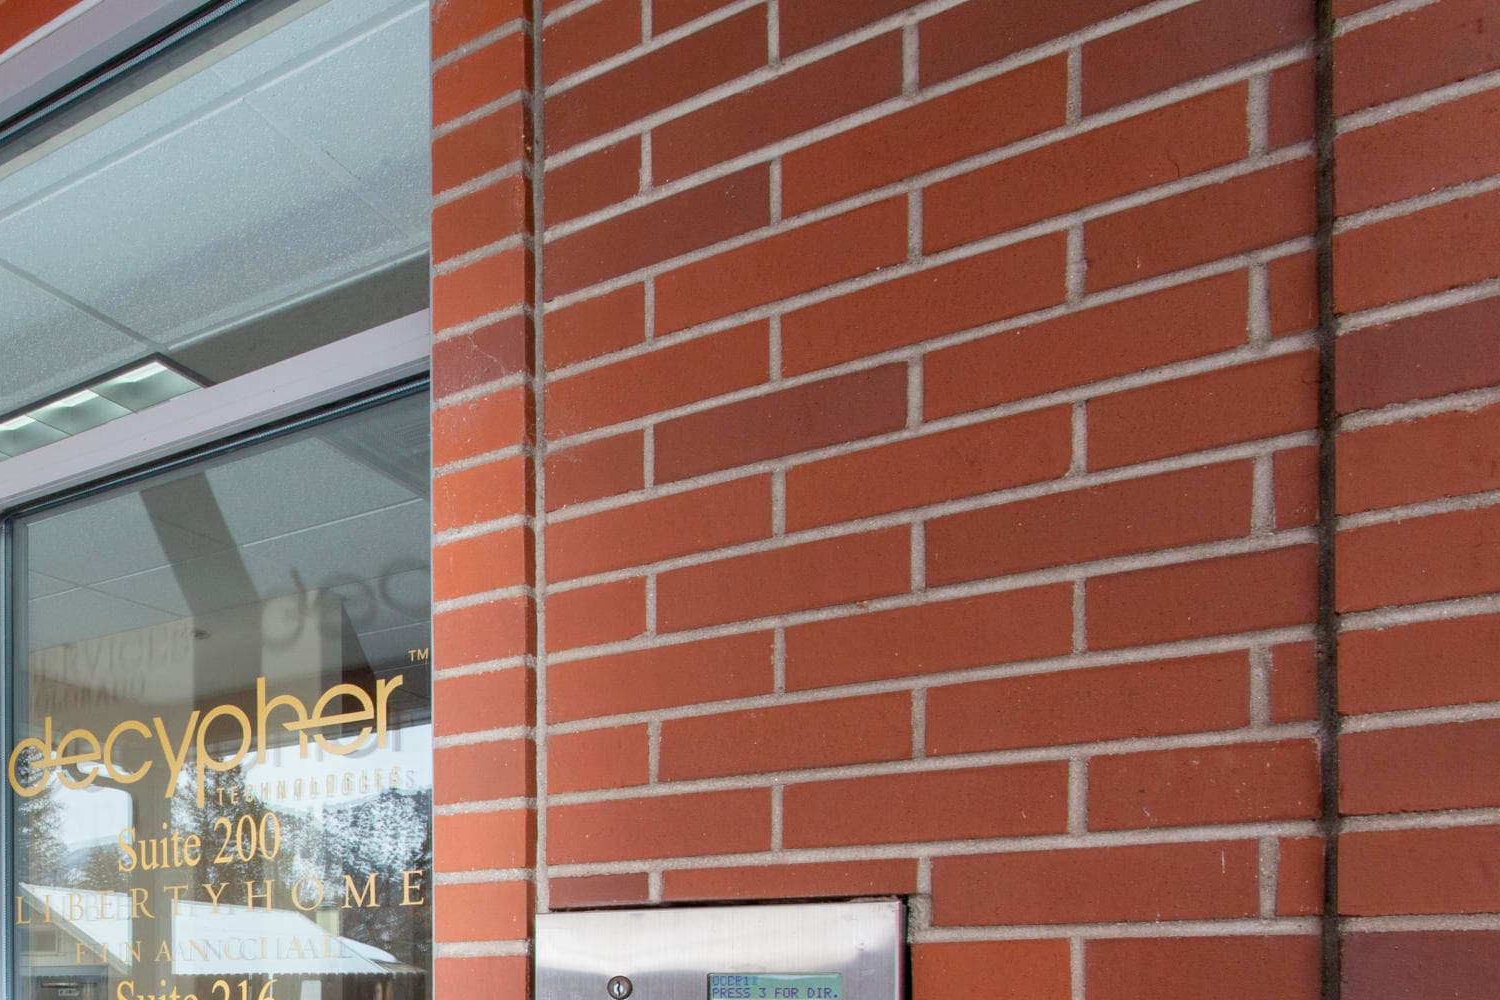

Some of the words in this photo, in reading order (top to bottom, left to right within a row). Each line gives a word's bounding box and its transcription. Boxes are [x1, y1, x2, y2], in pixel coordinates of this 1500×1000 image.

[8, 675, 403, 808] decypher
[118, 822, 202, 873] Suite
[213, 812, 280, 864] 200
[712, 988, 750, 998] PRESS
[759, 988, 766, 998] 3
[775, 988, 798, 998] FOR
[807, 988, 838, 998] DIR.
